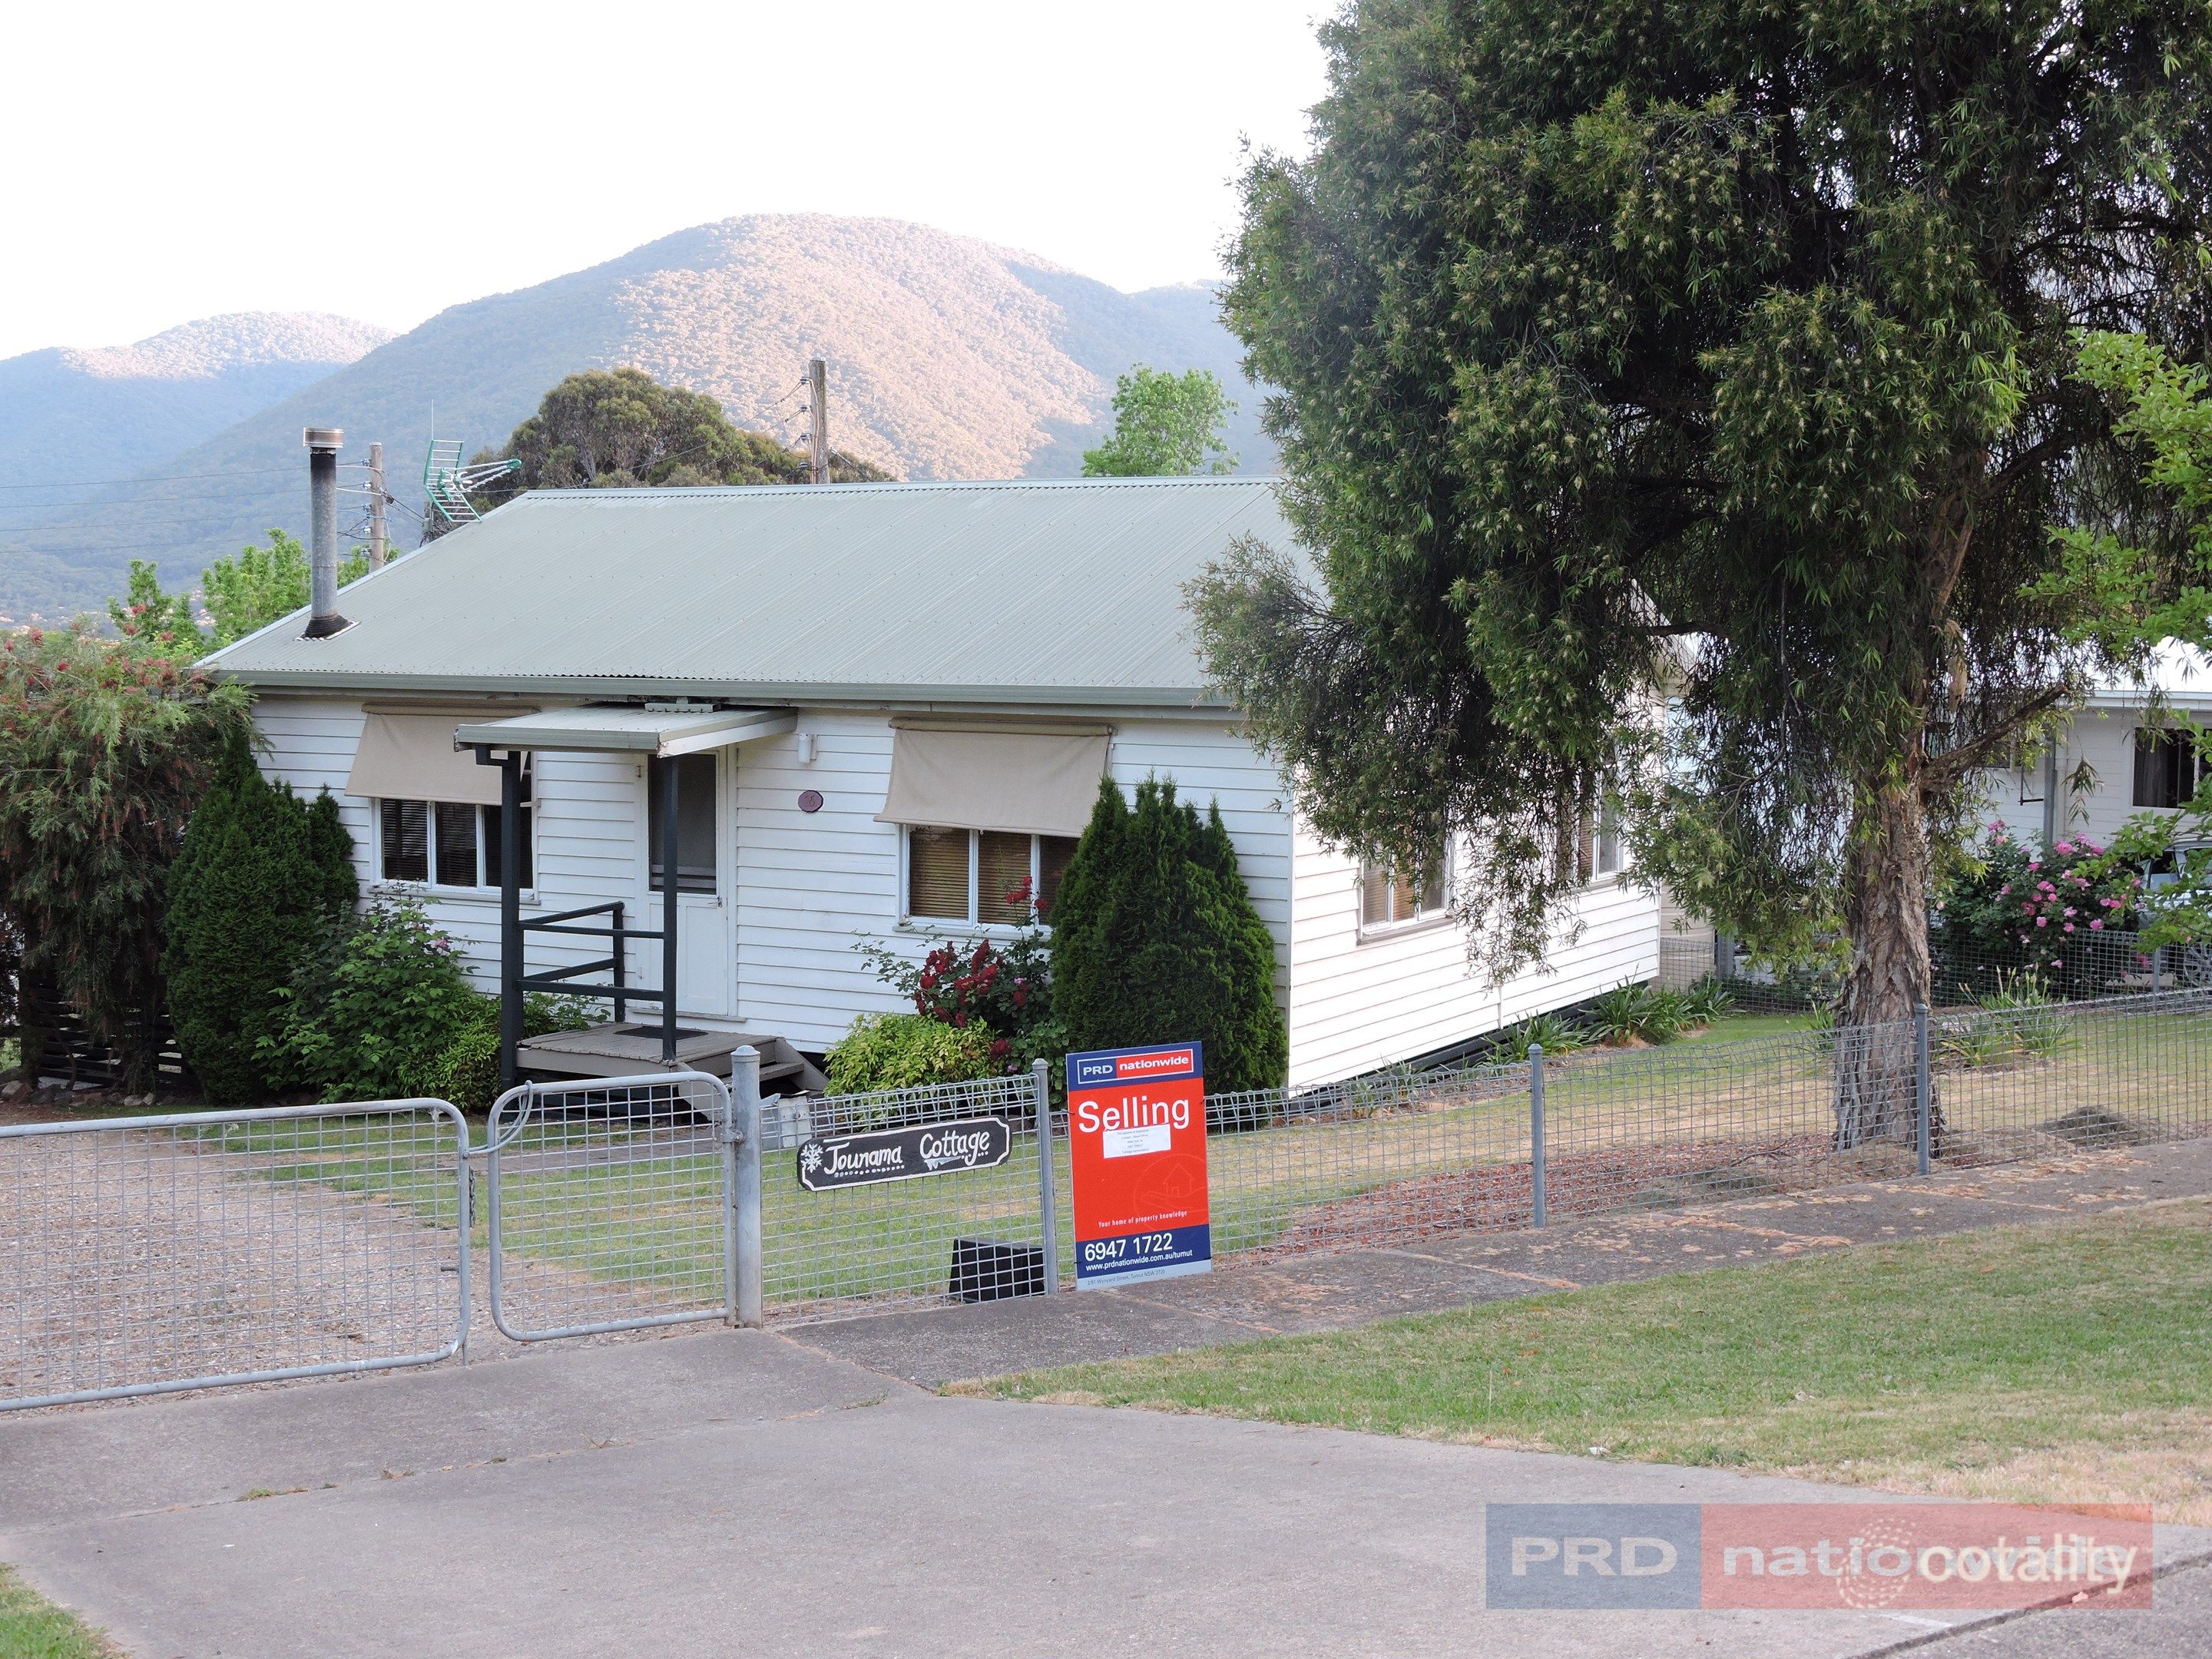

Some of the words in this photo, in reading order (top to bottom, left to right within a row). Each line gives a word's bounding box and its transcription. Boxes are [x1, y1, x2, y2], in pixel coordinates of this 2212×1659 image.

[1083, 1065, 1113, 1076] PRD
[1119, 1056, 1189, 1071] nationwide
[1078, 1095, 1190, 1133] Selling
[920, 1130, 990, 1166] Cottage
[1135, 1214, 1158, 1224] property
[1159, 1210, 1187, 1220] knowledge
[1084, 1239, 1127, 1262] 6947
[1133, 1233, 1173, 1254] 1722
[1085, 1249, 1193, 1271] www.prdnationwide.com.au/tumut
